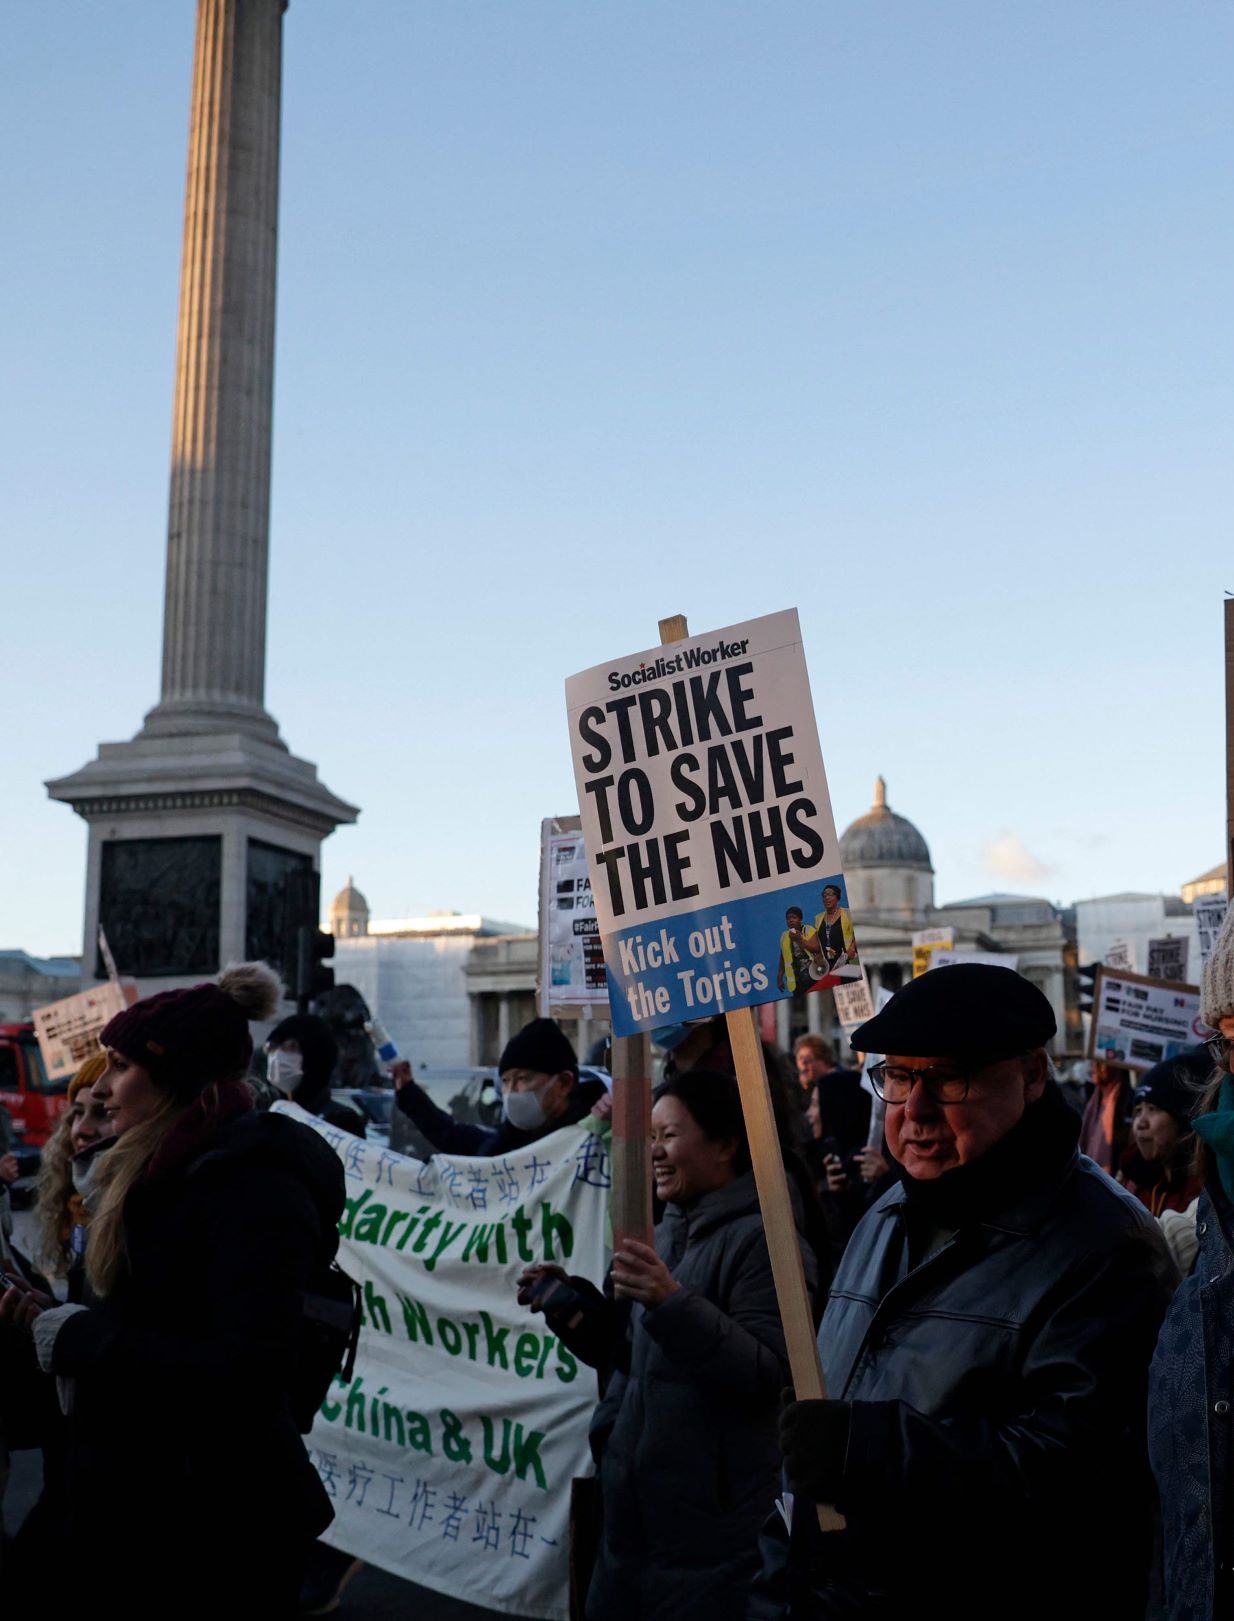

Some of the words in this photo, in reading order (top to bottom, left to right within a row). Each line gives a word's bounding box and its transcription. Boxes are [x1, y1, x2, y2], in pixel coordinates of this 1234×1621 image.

[608, 655, 683, 692] Socialist
[684, 638, 749, 669] Worker
[578, 662, 763, 773] STRIKE
[584, 767, 654, 844] TO
[670, 725, 804, 822] SAVE
[576, 878, 591, 891] FA
[595, 829, 700, 917] THE
[710, 797, 824, 888] NHS
[618, 927, 679, 976] Kick
[688, 915, 736, 960] out
[627, 984, 670, 1023] the
[677, 961, 768, 1003] Tories
[337, 1188, 467, 1271] darity
[462, 1201, 574, 1264] with
[396, 1293, 578, 1383] Workers
[440, 1408, 472, 1465] &
[481, 1415, 548, 1491] UK
